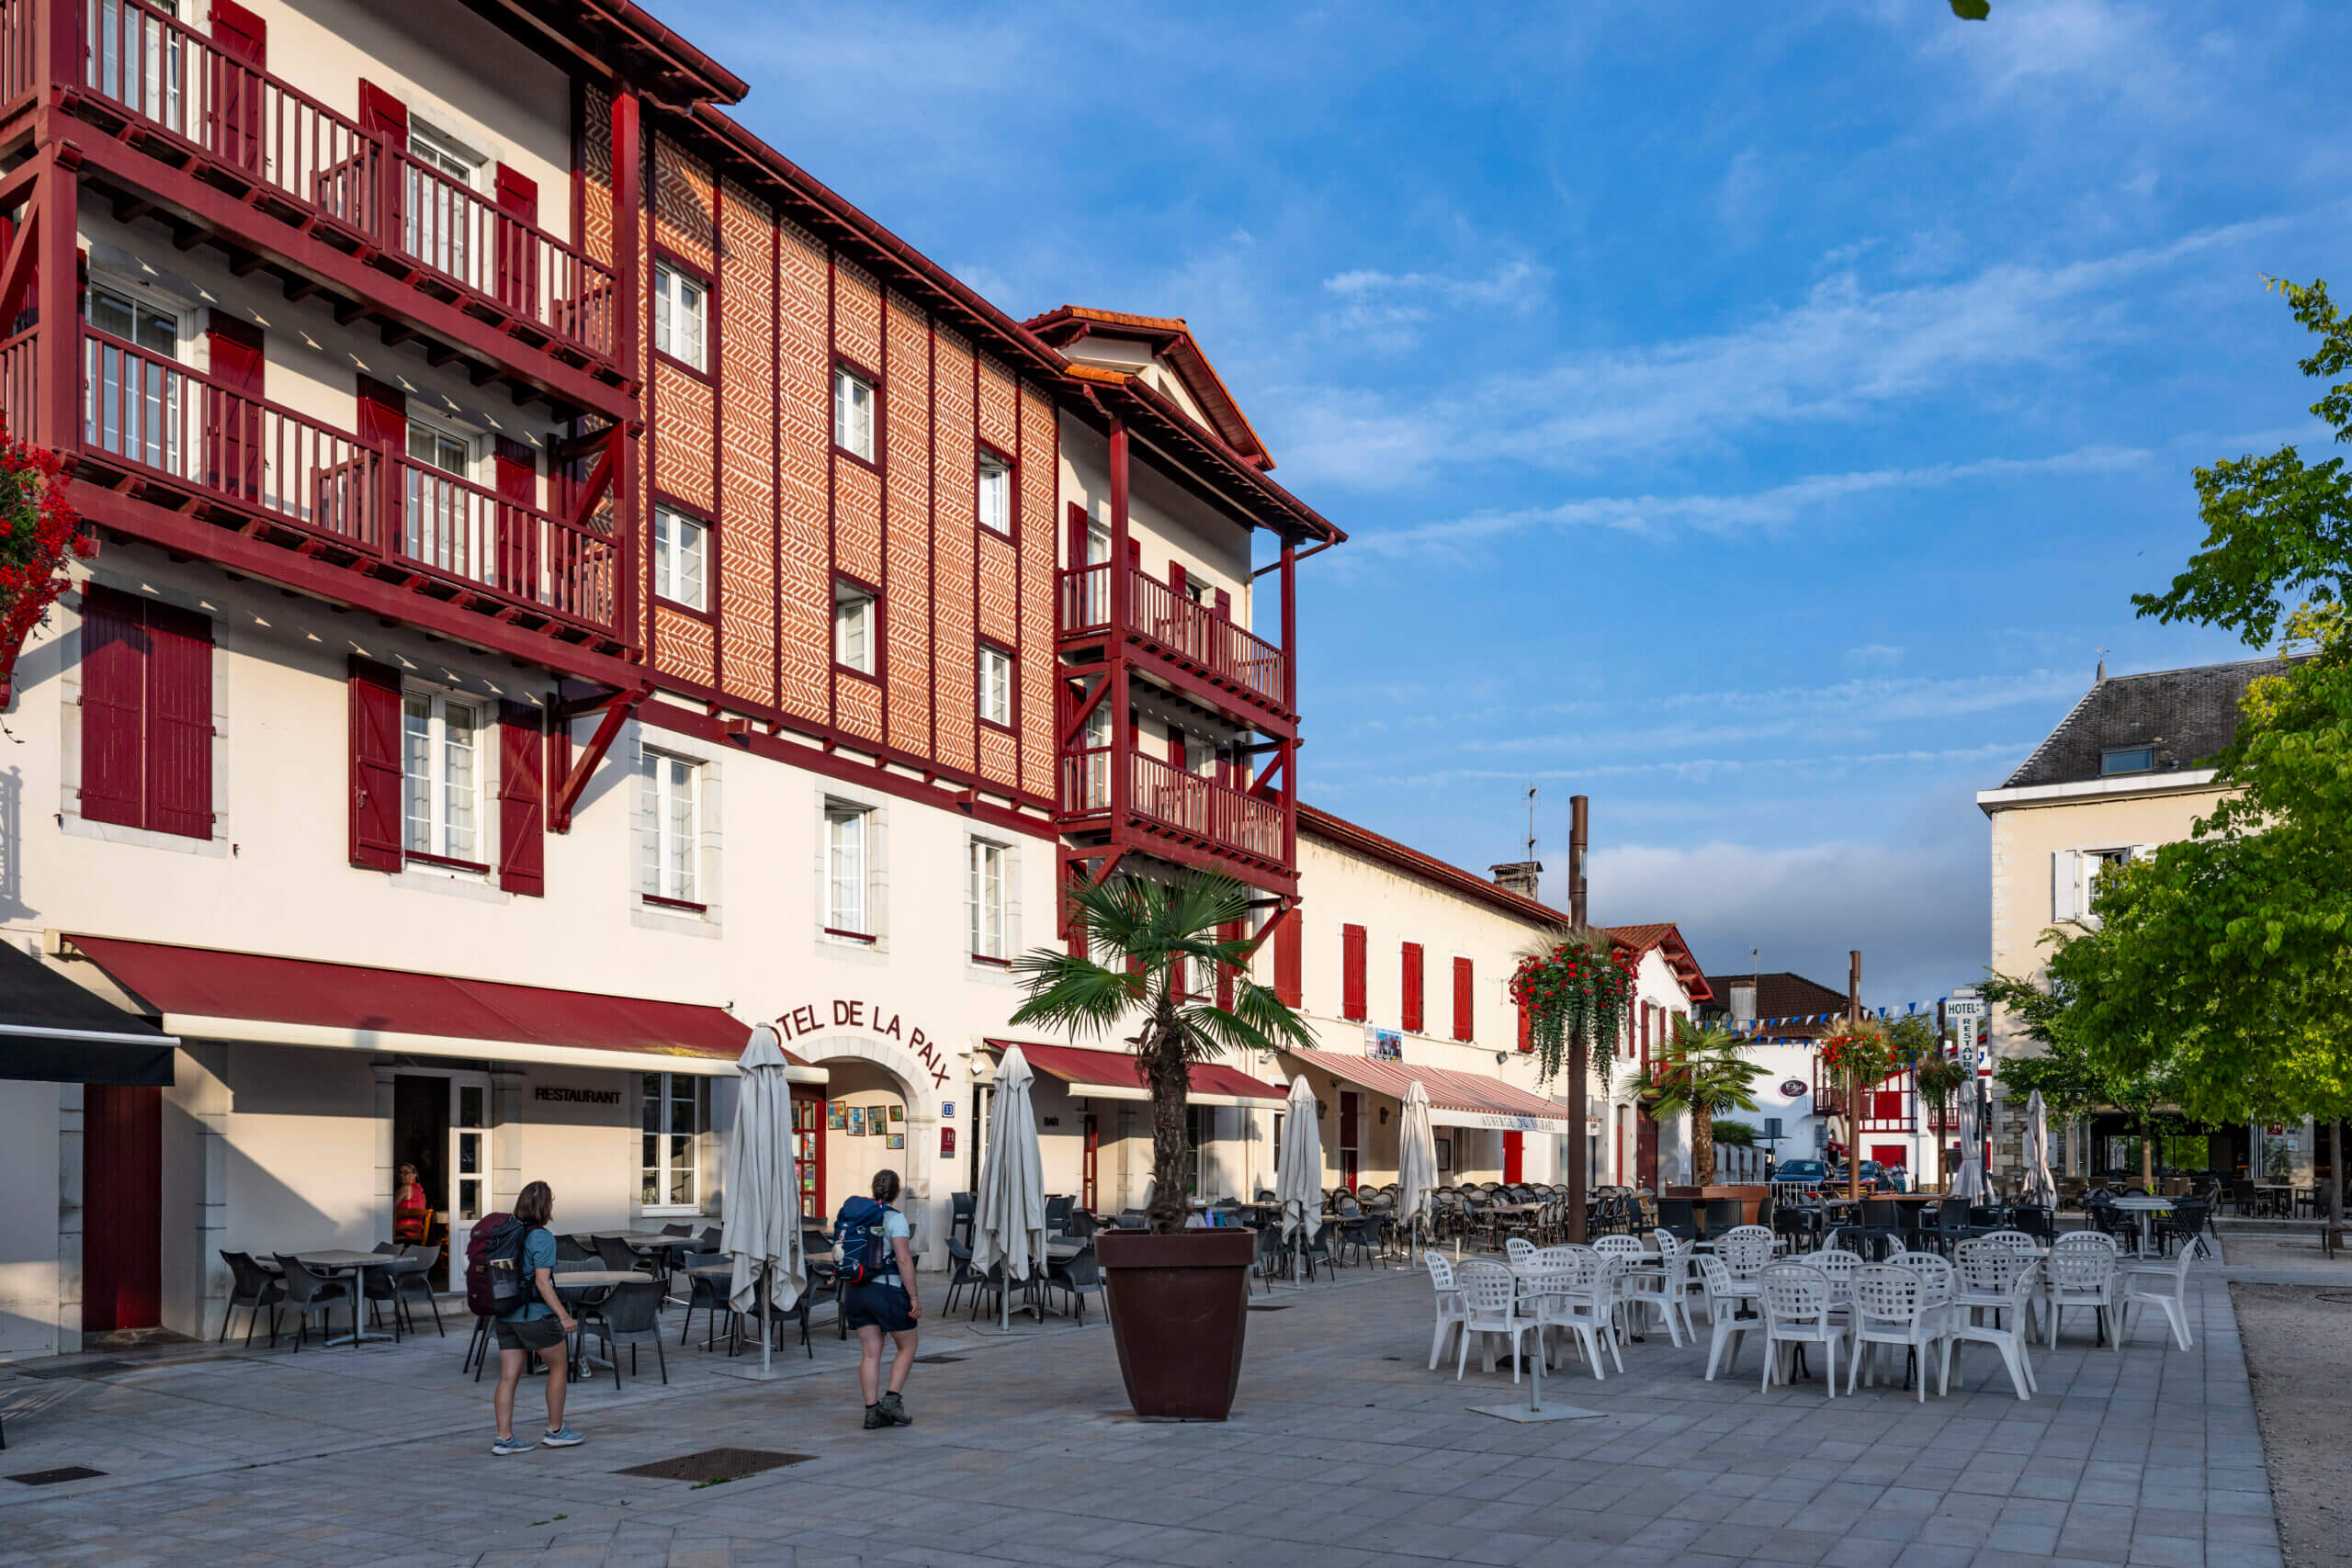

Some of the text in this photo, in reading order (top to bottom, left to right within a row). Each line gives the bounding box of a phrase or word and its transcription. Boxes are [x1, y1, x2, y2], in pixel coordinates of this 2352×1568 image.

[1948, 1003, 1976, 1015] HOTEL
[770, 1000, 950, 1089] TEL DE LA PAIX
[1962, 1018, 1973, 1081] RESTAURA
[535, 1087, 621, 1104] RESTAURANT
[1044, 1116, 1059, 1127] BAR
[947, 1132, 954, 1142] H
